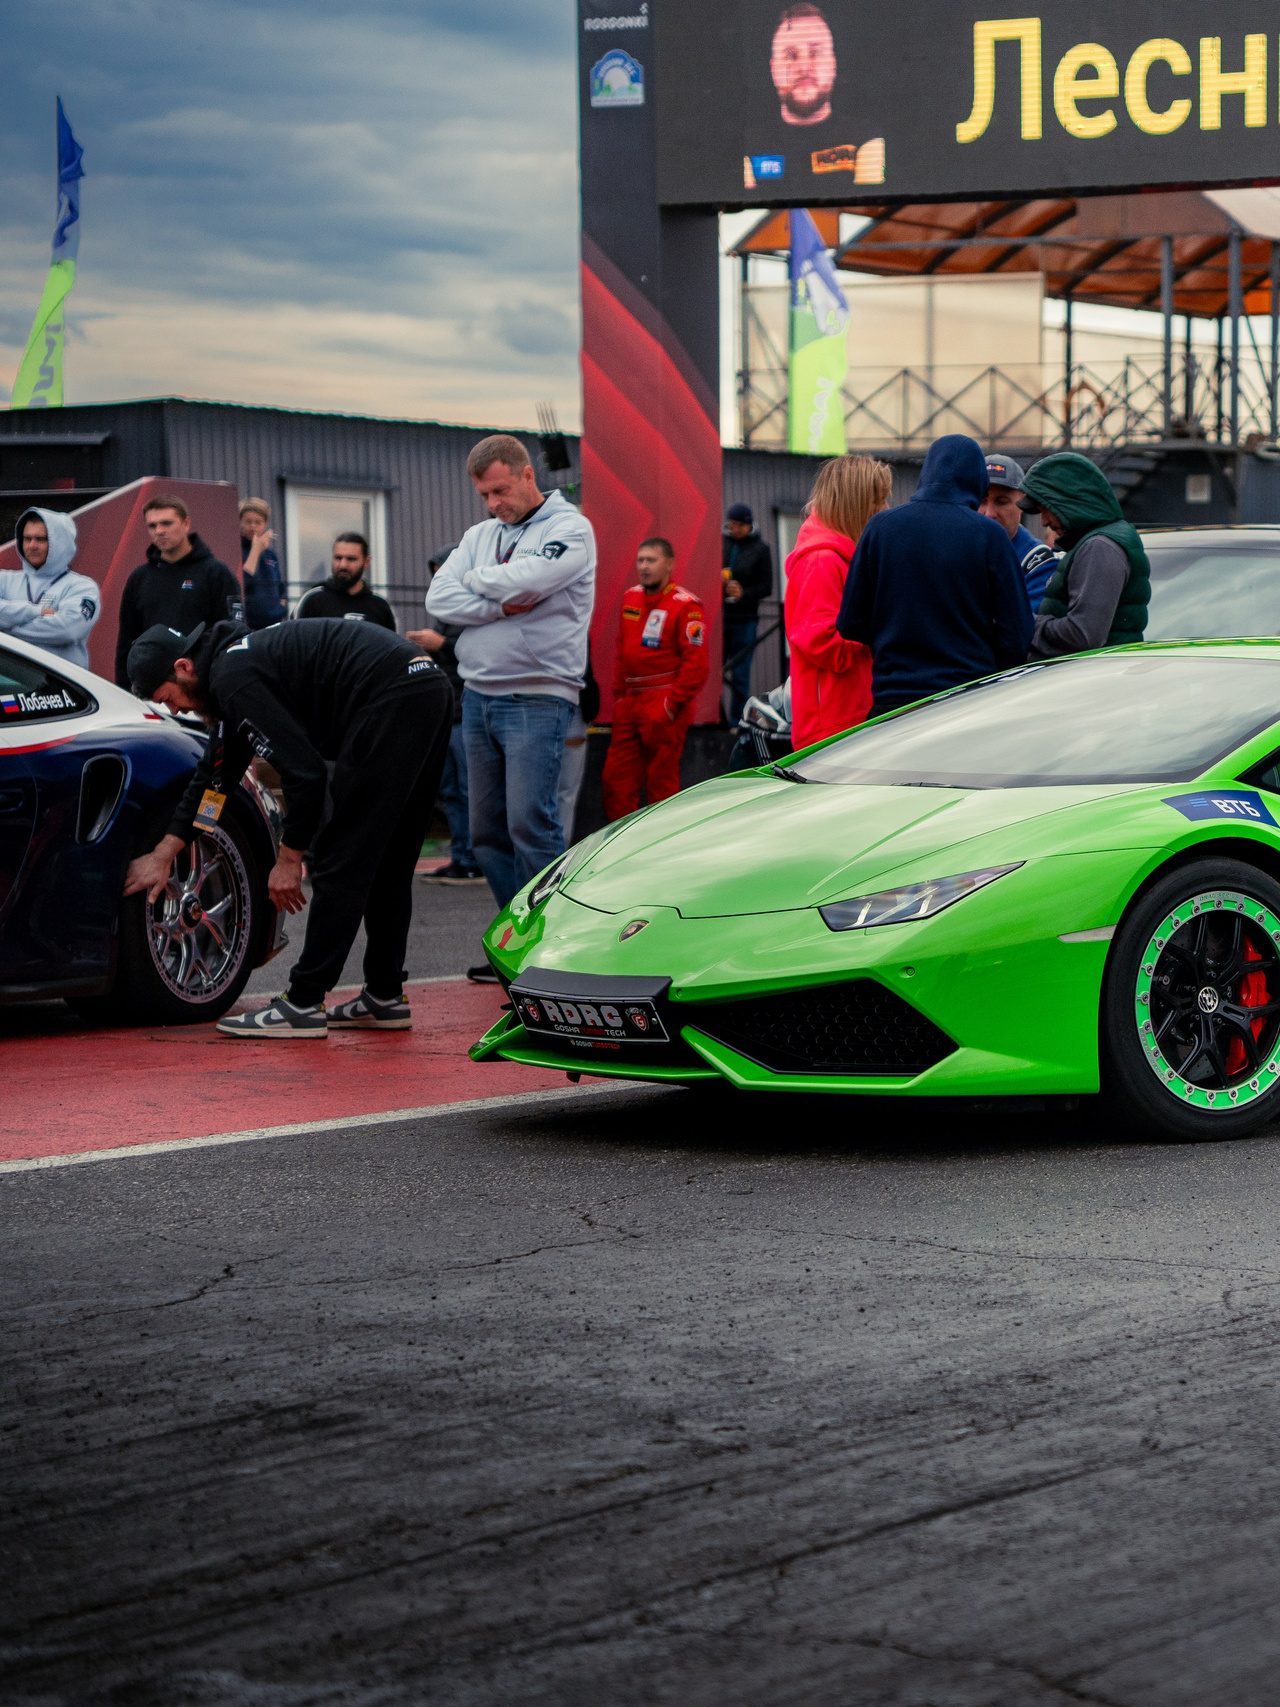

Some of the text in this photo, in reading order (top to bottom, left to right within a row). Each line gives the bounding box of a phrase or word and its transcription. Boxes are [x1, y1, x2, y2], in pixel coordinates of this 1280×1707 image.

[408, 662, 430, 674] NIKE
[17, 692, 64, 712] Лобачев
[1211, 800, 1261, 817] ВТБ
[540, 1000, 623, 1027] RDRC
